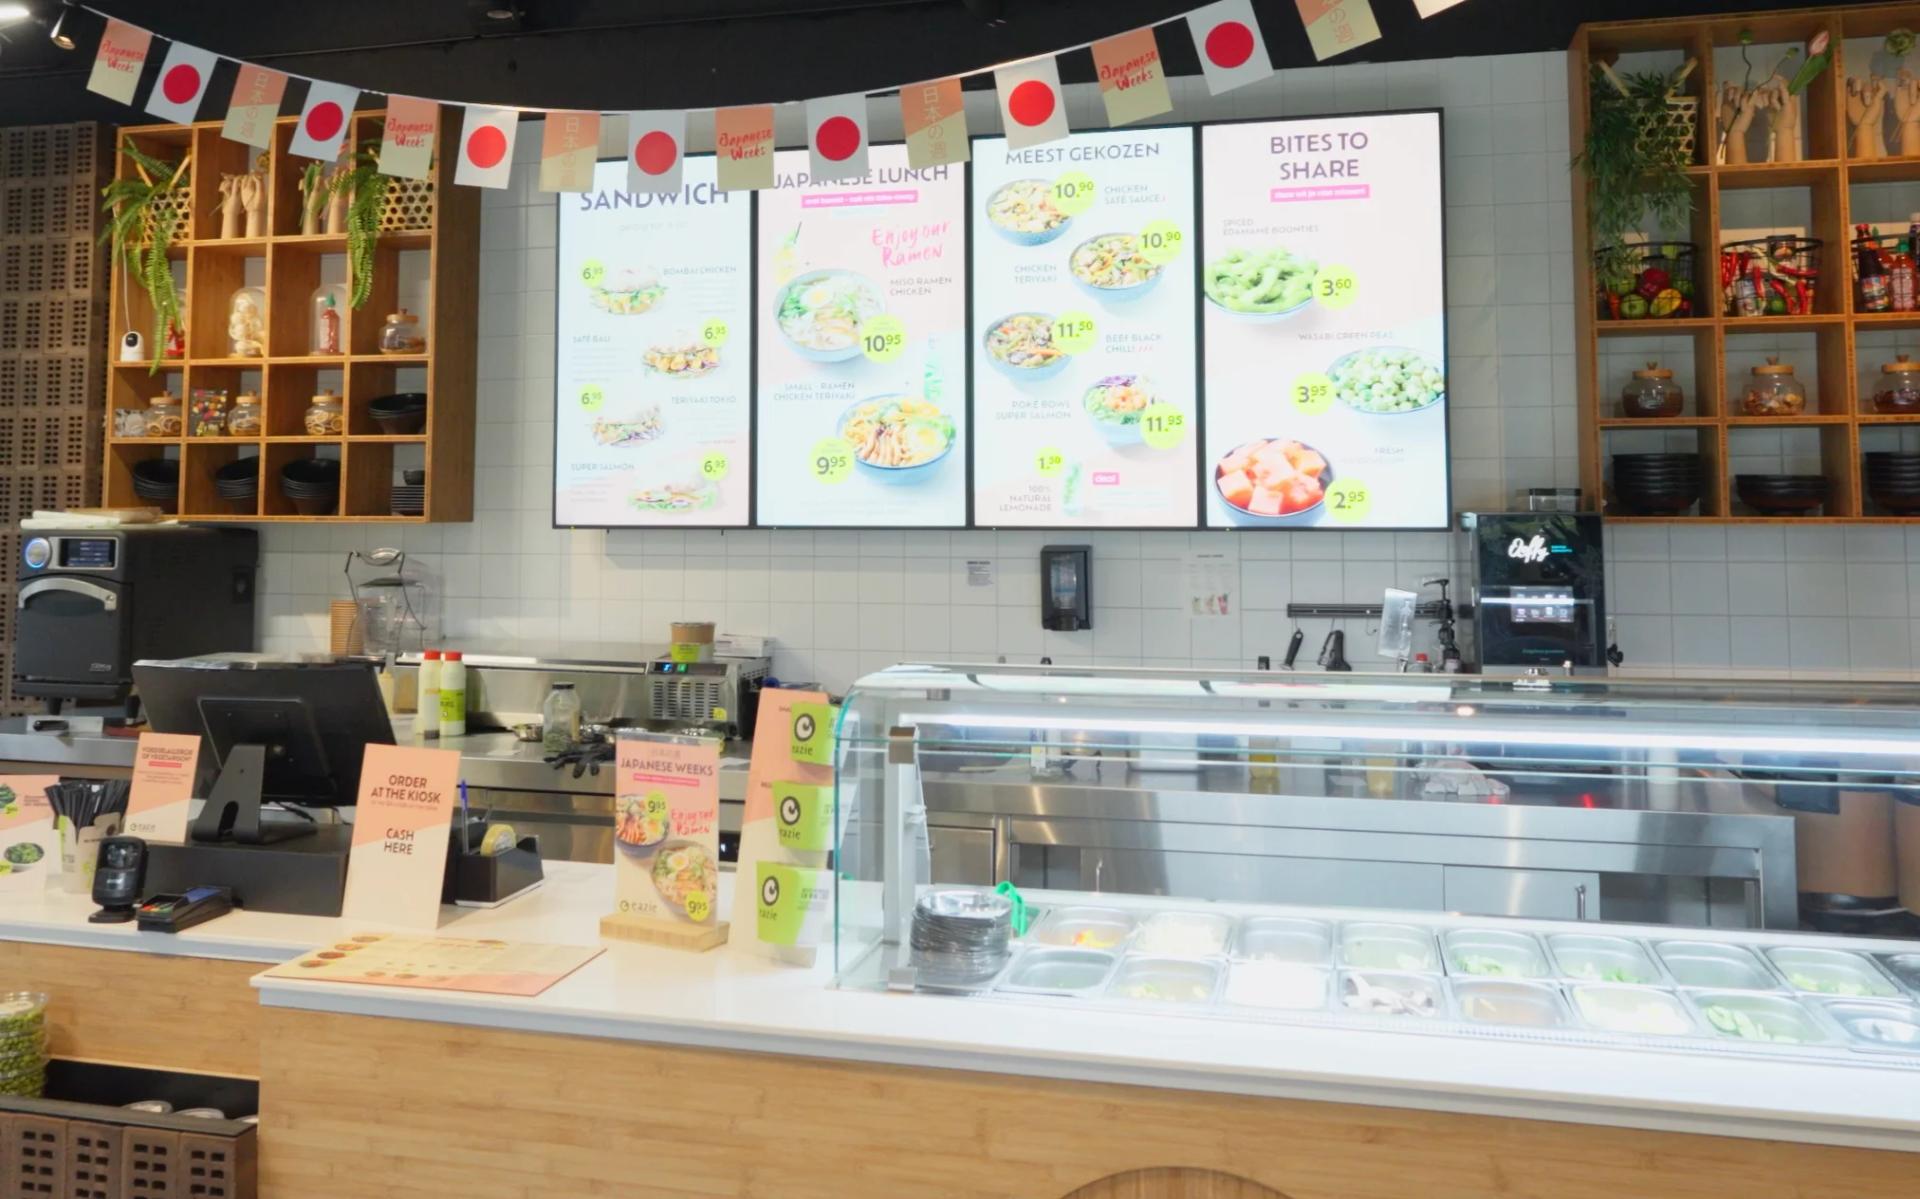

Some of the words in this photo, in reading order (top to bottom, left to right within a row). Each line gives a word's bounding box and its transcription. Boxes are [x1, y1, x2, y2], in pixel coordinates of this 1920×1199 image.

[1101, 50, 1157, 80] Japanese
[1115, 68, 1153, 91] Weeks
[719, 128, 772, 149] Japanese
[1271, 134, 1331, 154] BITES
[1338, 132, 1368, 150] TO
[730, 144, 766, 161] Weeks
[1006, 149, 1064, 164] MEEST
[1069, 143, 1159, 161] GEKOZEN
[879, 165, 948, 184] LUNCH
[1280, 159, 1359, 180] SHARE
[580, 183, 728, 211] SANDWICH
[1056, 182, 1094, 198] 10.90
[1142, 232, 1181, 248] 10.90
[1322, 279, 1352, 297] 3.60
[1058, 321, 1093, 338] 11.50
[864, 334, 901, 352] 10.95
[1297, 386, 1327, 403] 3.95
[1147, 415, 1182, 432] 11.95
[816, 456, 846, 475] 9.95
[1333, 491, 1364, 509] 2.95
[620, 758, 672, 772] JAPANESE
[675, 762, 713, 776] WEEKS
[389, 774, 427, 788] ORDER
[371, 787, 384, 798] AT
[386, 788, 406, 800] THE
[407, 790, 441, 803] KIOSK
[386, 828, 414, 841] CASH
[384, 842, 413, 855] HERE
